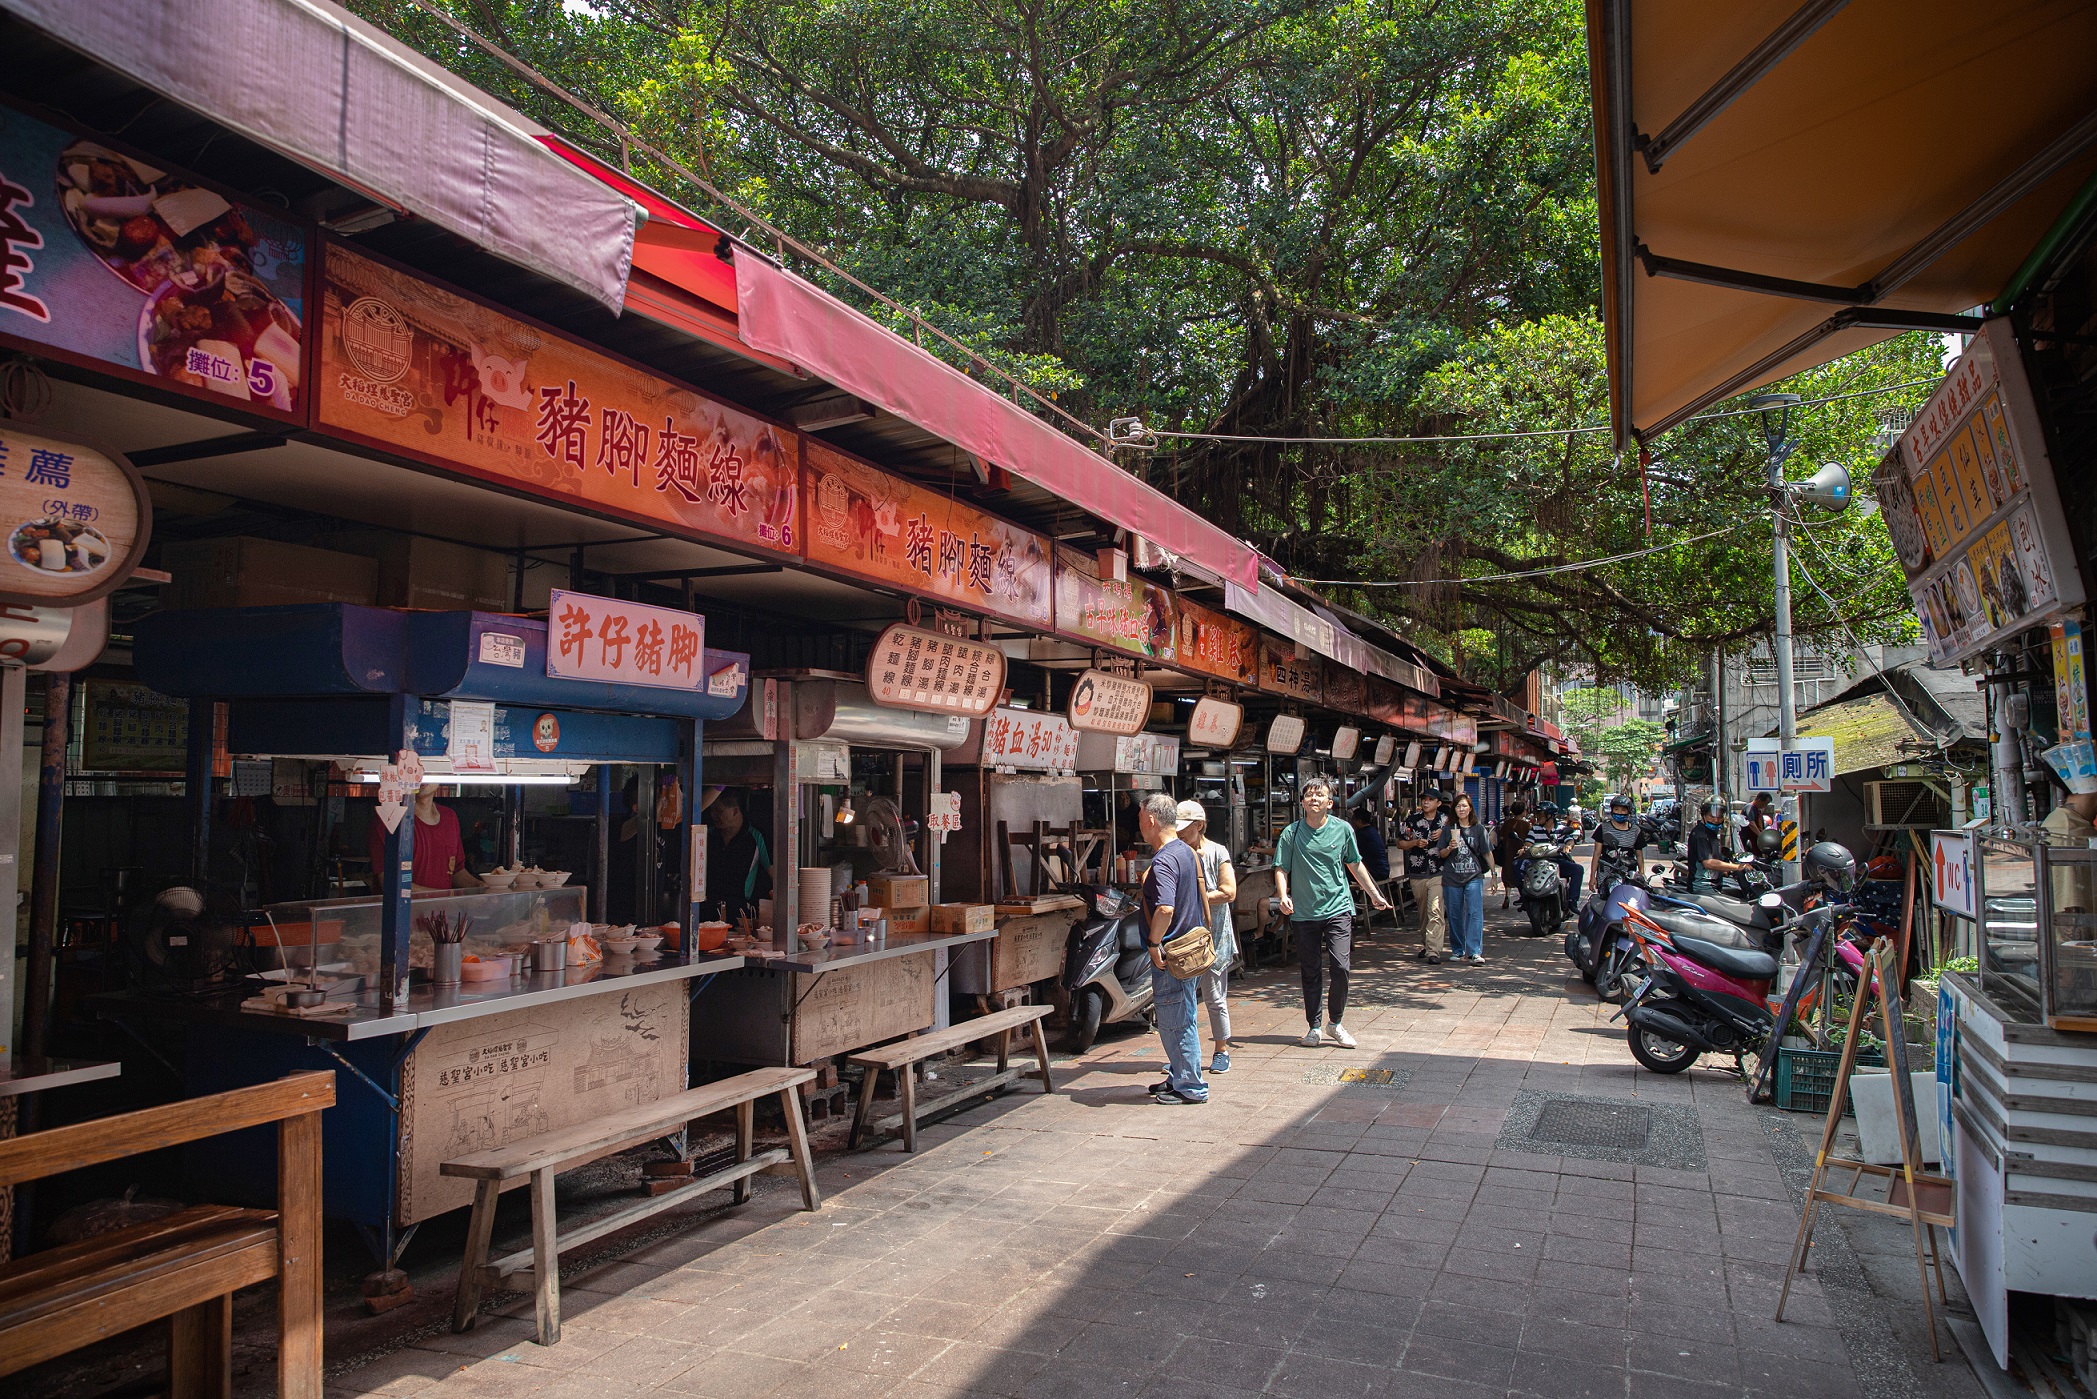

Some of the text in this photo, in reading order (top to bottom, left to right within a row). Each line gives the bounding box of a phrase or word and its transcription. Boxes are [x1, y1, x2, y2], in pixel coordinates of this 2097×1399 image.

[344, 392, 407, 417] DA DAO CHENG
[1912, 359, 1982, 464] 古早味傳統甜品
[535, 378, 751, 518] 豬腳麵線
[1939, 464, 1964, 534] 豆花
[1958, 442, 1983, 513] 仙草
[41, 499, 100, 523] (外帶)
[906, 512, 1020, 602] 豬腳麵線
[1084, 593, 1150, 646] 古早味豬血湯
[883, 632, 906, 685] 乾麵線
[900, 635, 923, 688] 豬腳麵線
[918, 639, 939, 690] 豬腳湯
[1209, 624, 1243, 673] 雞卷
[881, 686, 891, 696] 40
[963, 649, 983, 697] 綜合麵線
[976, 652, 996, 699] 綜合湯
[1276, 664, 1311, 695] 四神湯
[1163, 745, 1175, 769] 70
[1782, 752, 1827, 779] 廁所
[929, 813, 961, 831] 取餐區
[1946, 861, 1961, 891] WC
[439, 1050, 549, 1087] 慈聖宮小吃 慈聖宮小吃
